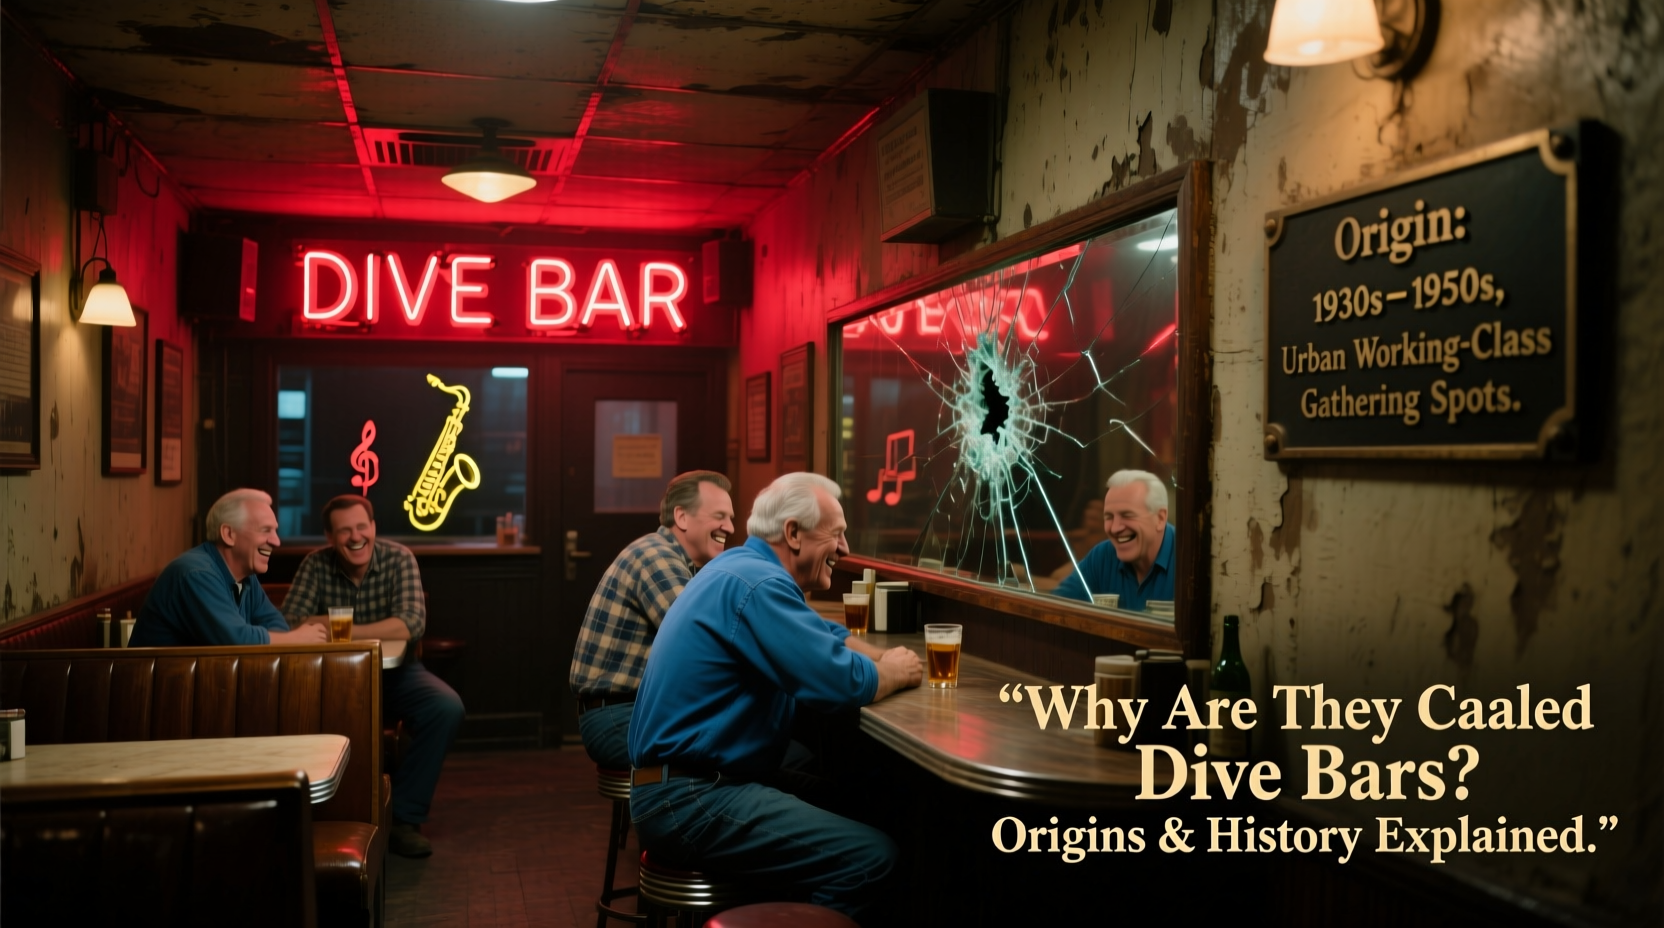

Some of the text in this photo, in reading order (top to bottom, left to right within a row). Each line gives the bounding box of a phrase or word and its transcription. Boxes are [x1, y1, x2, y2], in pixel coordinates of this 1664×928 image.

[1334, 199, 1468, 264] Origin:
[299, 249, 690, 332] DIVE BAR
[1281, 321, 1553, 376] Urban Working-Class
[1300, 379, 1523, 426] Gathering Spots.
